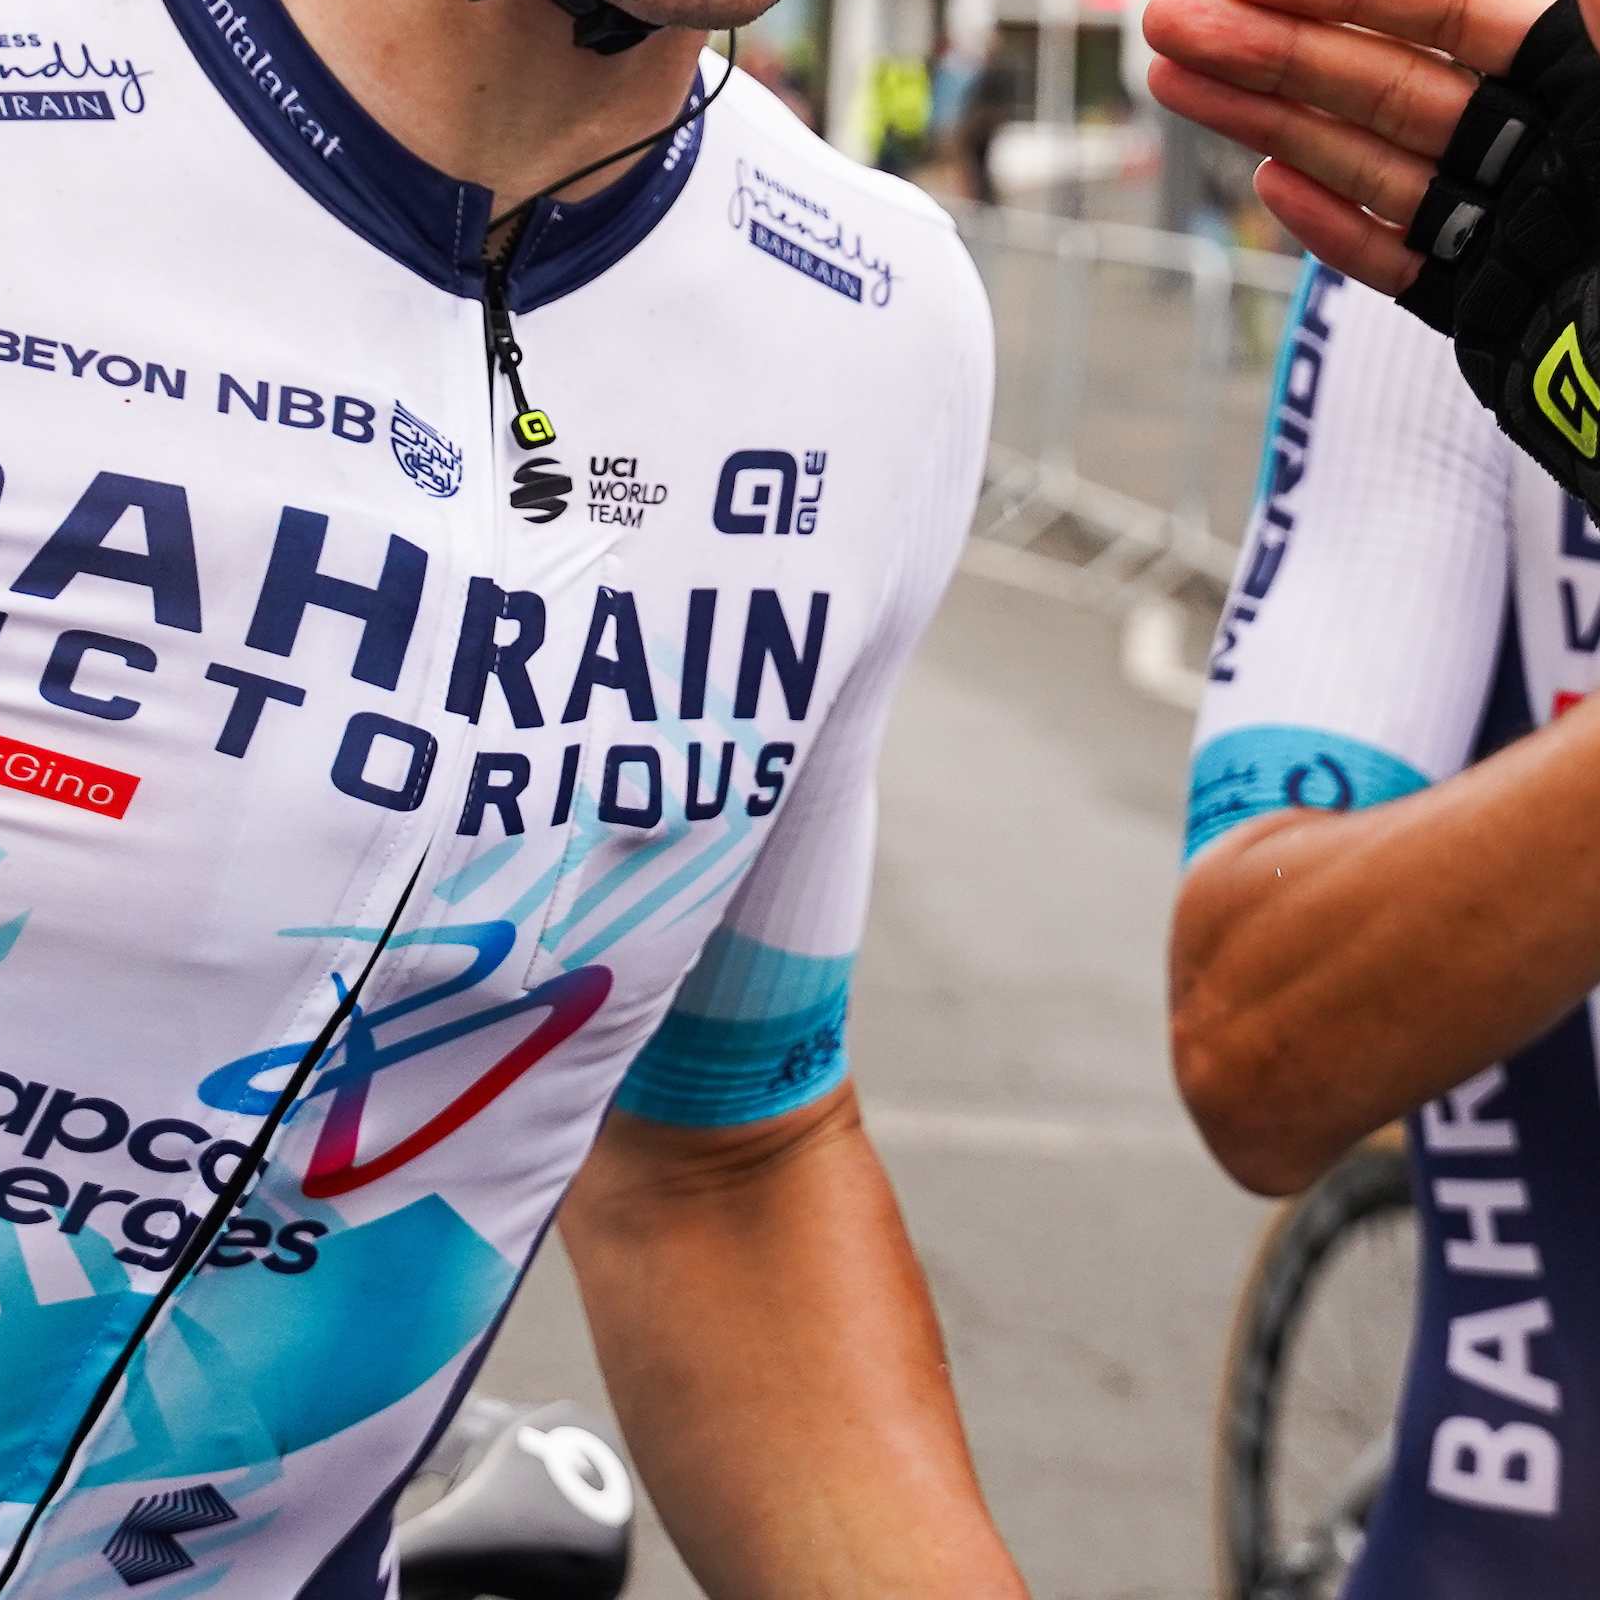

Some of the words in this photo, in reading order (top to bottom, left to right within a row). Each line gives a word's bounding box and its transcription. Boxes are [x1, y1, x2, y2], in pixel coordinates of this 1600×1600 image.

[755, 223, 859, 299] BAHRAIN
[217, 373, 376, 444] NBB
[590, 456, 638, 478] UCI
[589, 481, 668, 505] WORLD
[588, 504, 644, 529] TEAM
